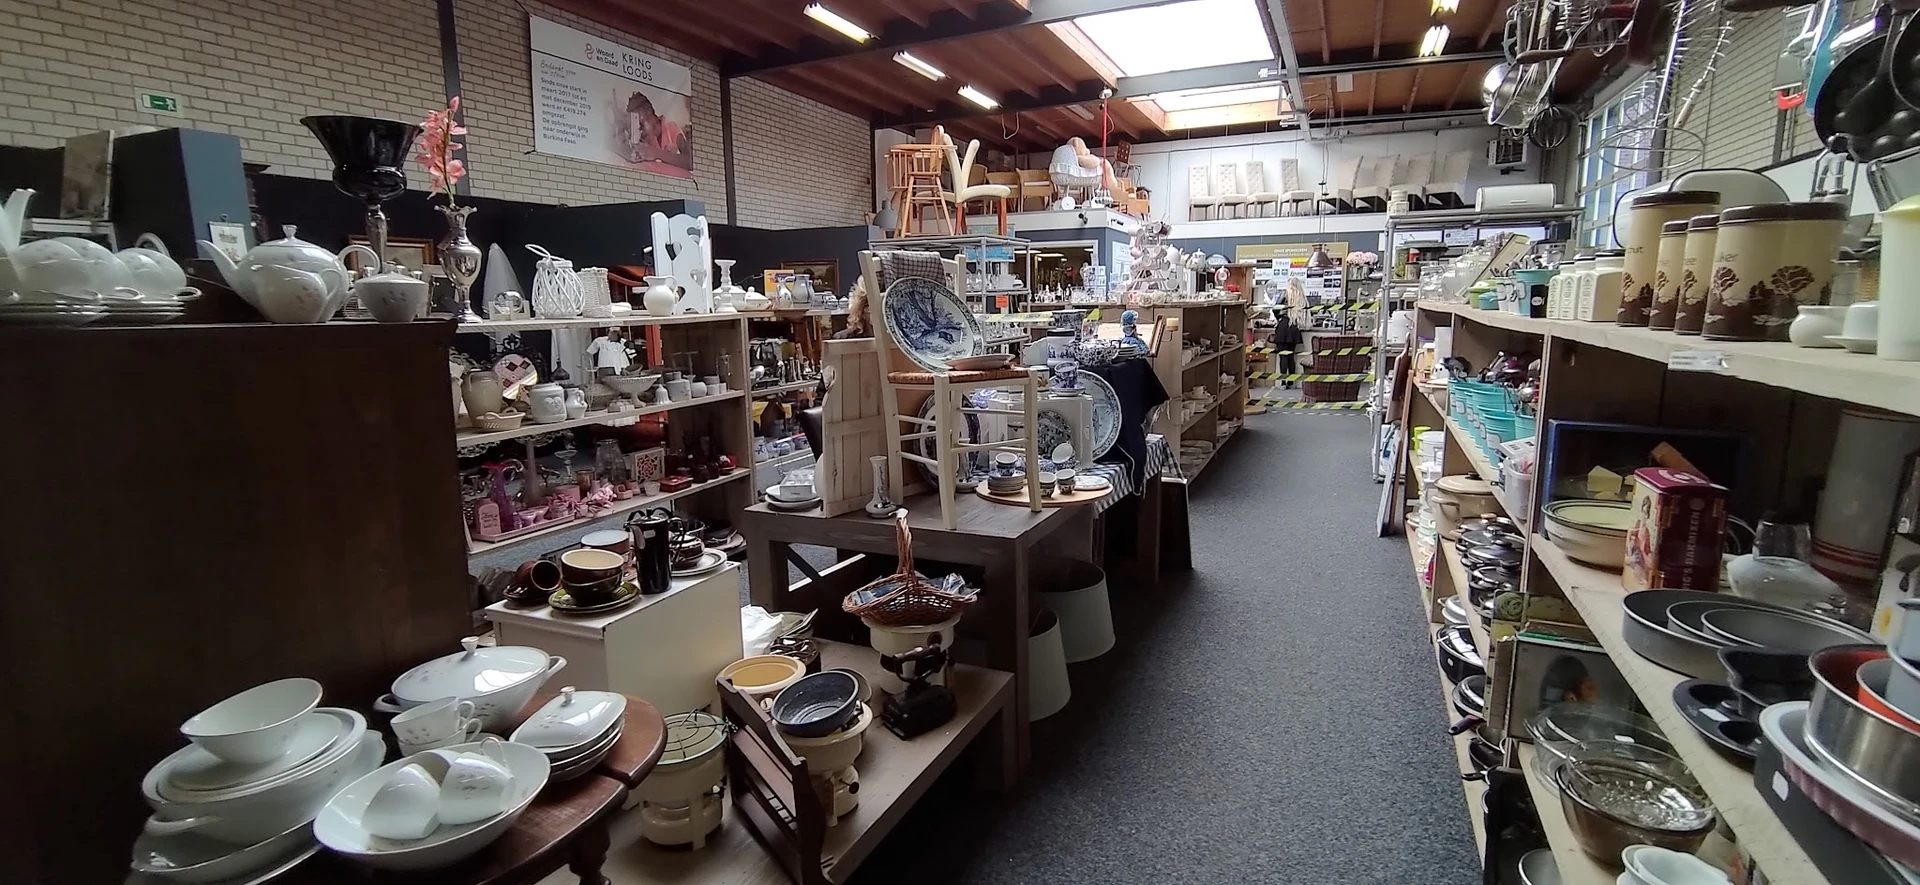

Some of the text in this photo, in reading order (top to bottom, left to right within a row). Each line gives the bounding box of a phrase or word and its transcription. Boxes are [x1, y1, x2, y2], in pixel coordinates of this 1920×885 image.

[596, 48, 614, 59] Woord
[604, 57, 619, 67] Daad
[622, 52, 652, 70] KRING
[622, 64, 653, 81] LOODS
[541, 77, 555, 86] Sinds
[541, 86, 557, 94] maart
[553, 97, 578, 107] december
[551, 119, 577, 130] opbrengst
[577, 125, 589, 133] ging
[543, 133, 564, 142] Burkina
[556, 128, 581, 139] onderwijs
